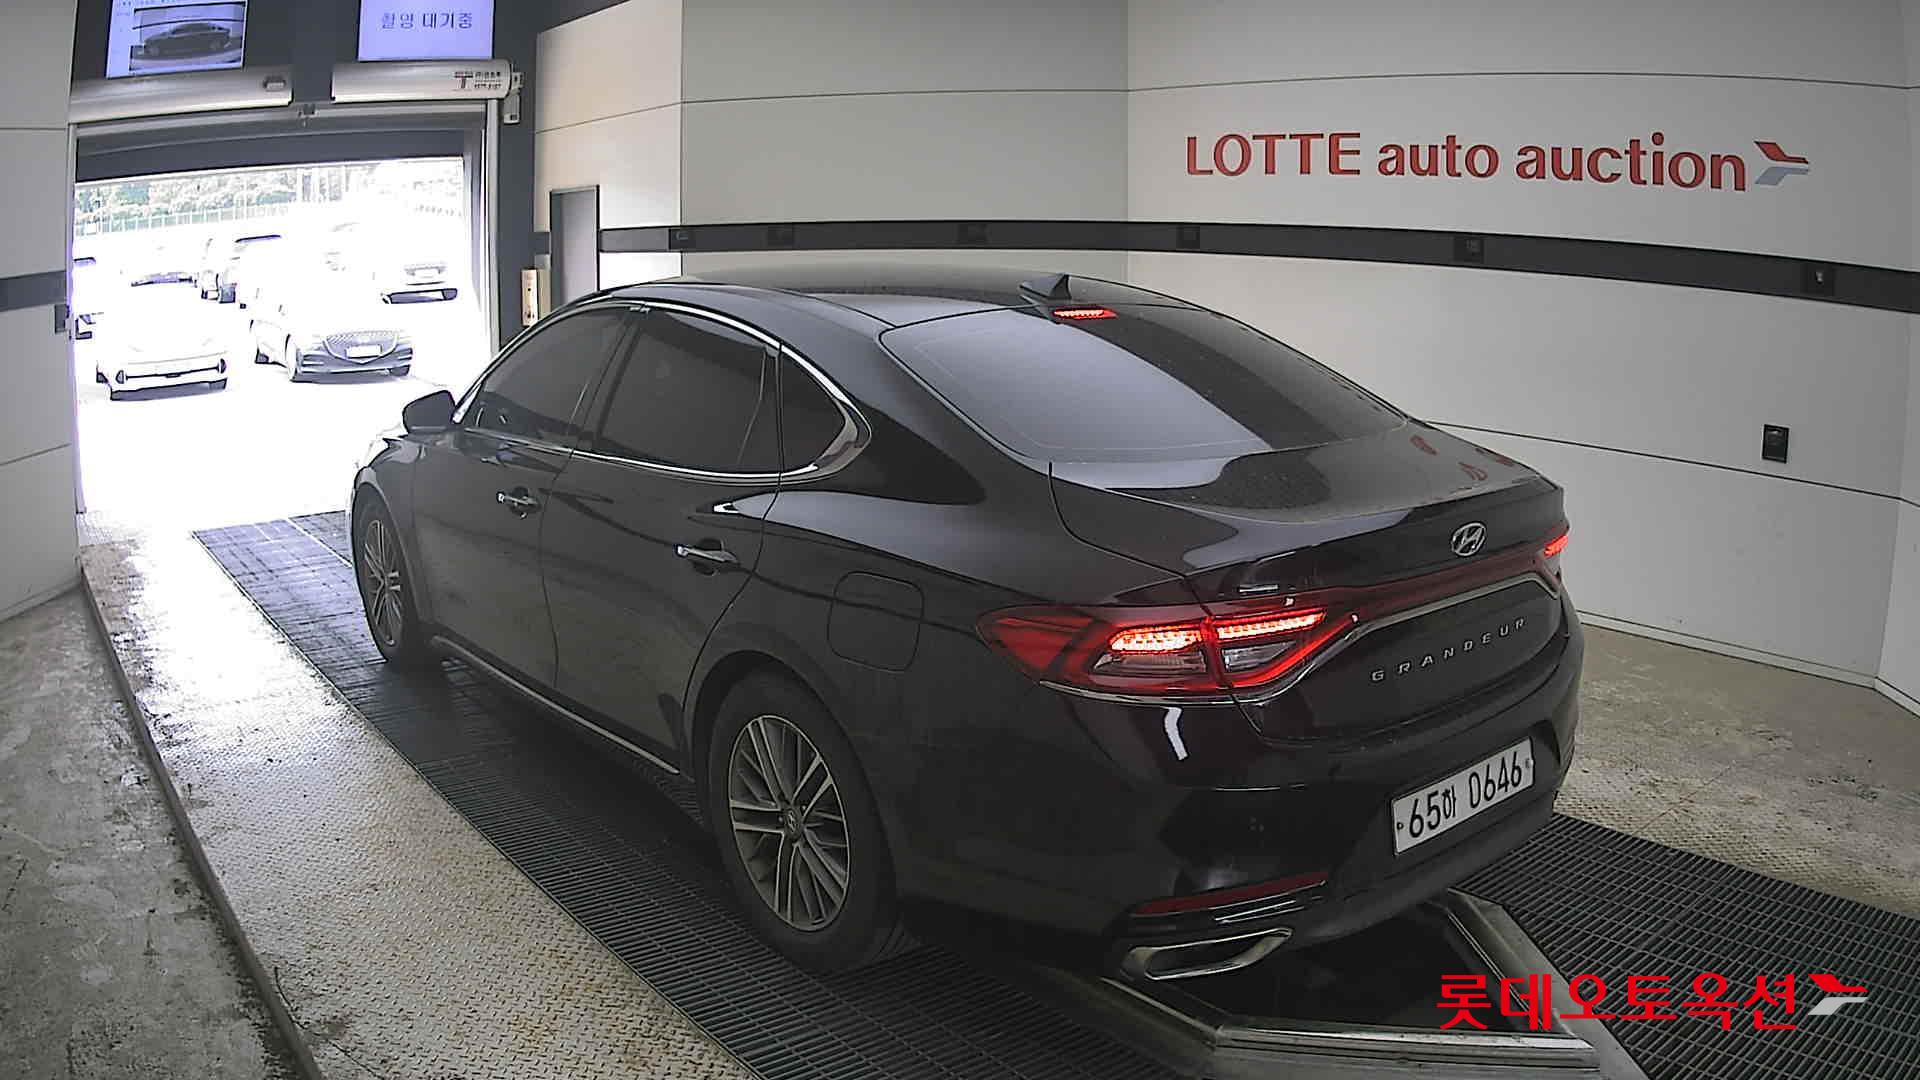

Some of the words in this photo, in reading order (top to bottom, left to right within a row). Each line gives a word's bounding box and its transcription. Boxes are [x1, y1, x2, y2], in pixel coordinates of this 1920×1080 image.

[422, 12, 473, 29] 대기중
[1186, 133, 1361, 176] LOTTE
[1377, 134, 1499, 179] auto
[1515, 132, 1747, 191] auction
[1371, 616, 1528, 682] GRANDEUR
[1408, 785, 1457, 838] 65하
[1468, 751, 1523, 809] 0646
